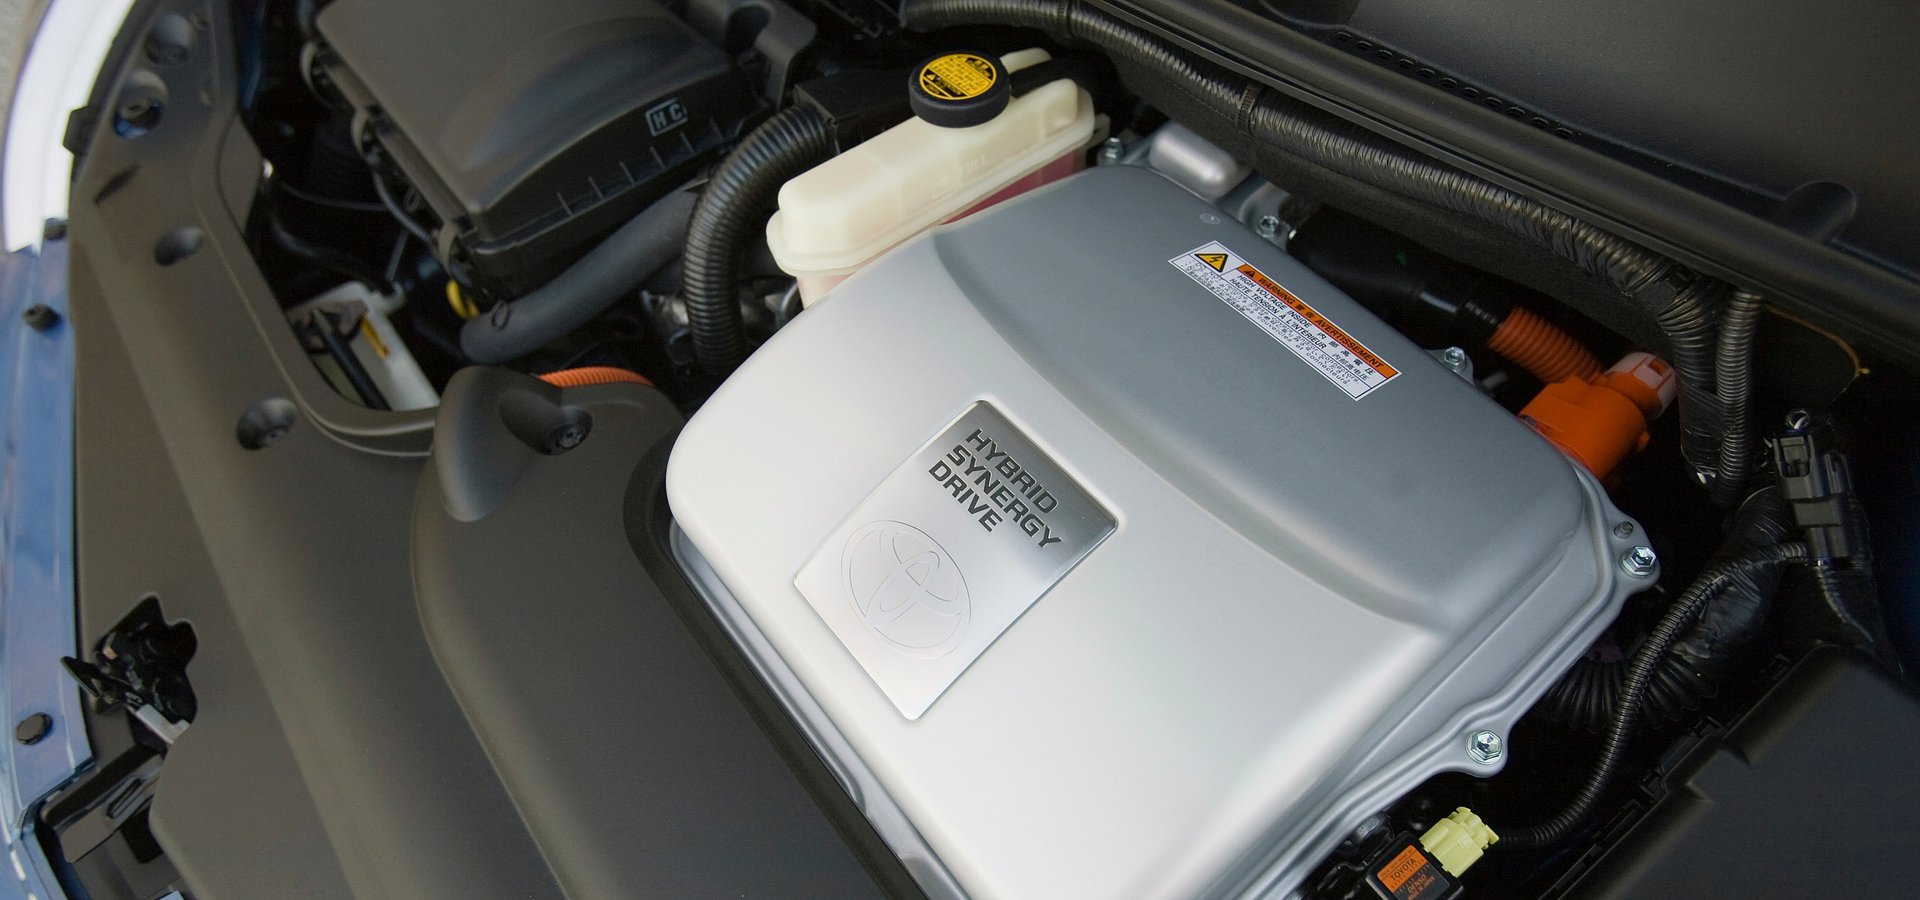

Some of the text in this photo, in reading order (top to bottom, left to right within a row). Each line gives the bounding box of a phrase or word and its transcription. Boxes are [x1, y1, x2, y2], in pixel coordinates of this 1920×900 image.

[1228, 277, 1254, 295] HAUTE
[1249, 292, 1280, 314] TENSION
[1236, 274, 1313, 328] HIGH VOLTAGE INSIDE
[1256, 277, 1296, 304] WARNING
[1313, 318, 1385, 369] AVERTISSEMENT
[928, 460, 1003, 533] DRIVE
[946, 444, 1062, 548] SYNERGY
[965, 428, 1058, 514] HYBRID
[1391, 857, 1417, 881] TOYOTA
[1408, 874, 1427, 893] DENSO
